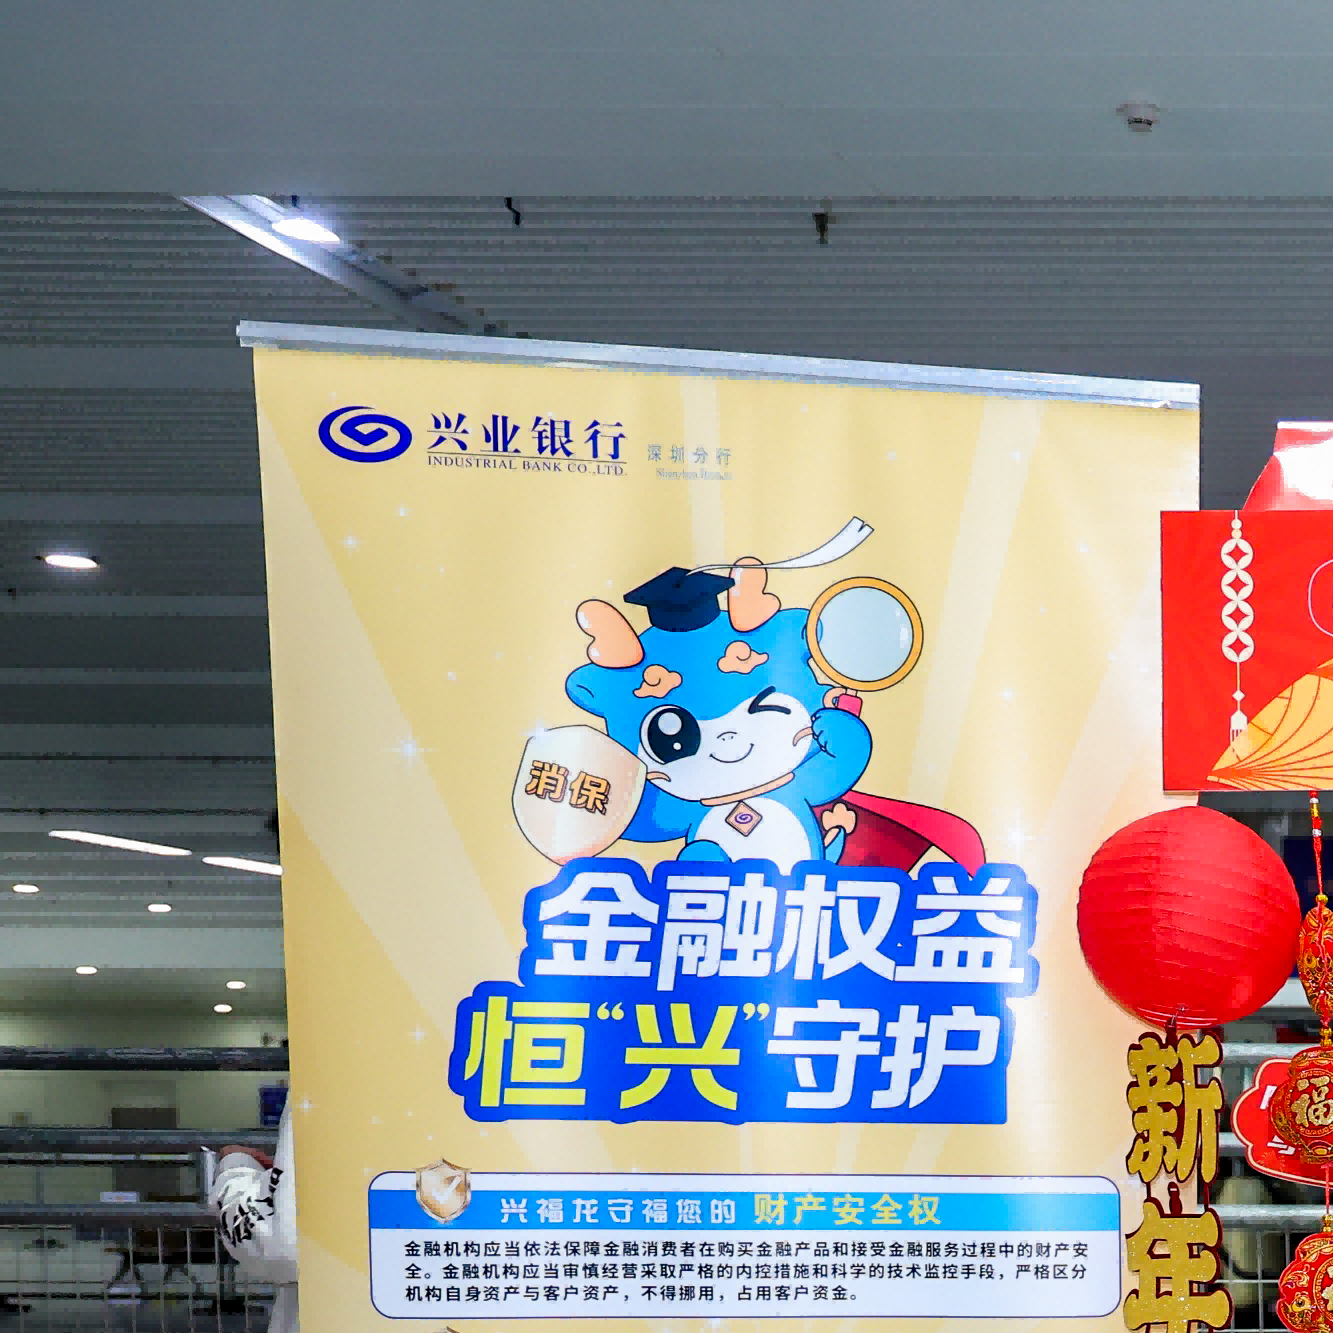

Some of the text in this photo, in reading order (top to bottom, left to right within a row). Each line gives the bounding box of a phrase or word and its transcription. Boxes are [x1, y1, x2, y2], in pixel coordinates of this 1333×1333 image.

[427, 412, 628, 460] 兴业银行
[428, 455, 517, 471] INDUSTRIAL
[522, 459, 562, 473] BANK
[525, 760, 613, 815] 消保
[533, 873, 1026, 992] 金融权益
[466, 996, 1000, 1110] 恒“兴”守护
[500, 1192, 942, 1226] 兴福龙守福您的 财产安全权
[404, 1240, 1089, 1258] 金融机构应当依法保障金融消费者在购买金融产品和接受金融服务过程中的财产安
[405, 1262, 1087, 1281] 全。金融机构应当审慎经营采取严格的内控措施和科学的技术监控手段，严格区分
[405, 1284, 859, 1303] 机构自身资产与客户资产，不得挪用，占用客户资金。
